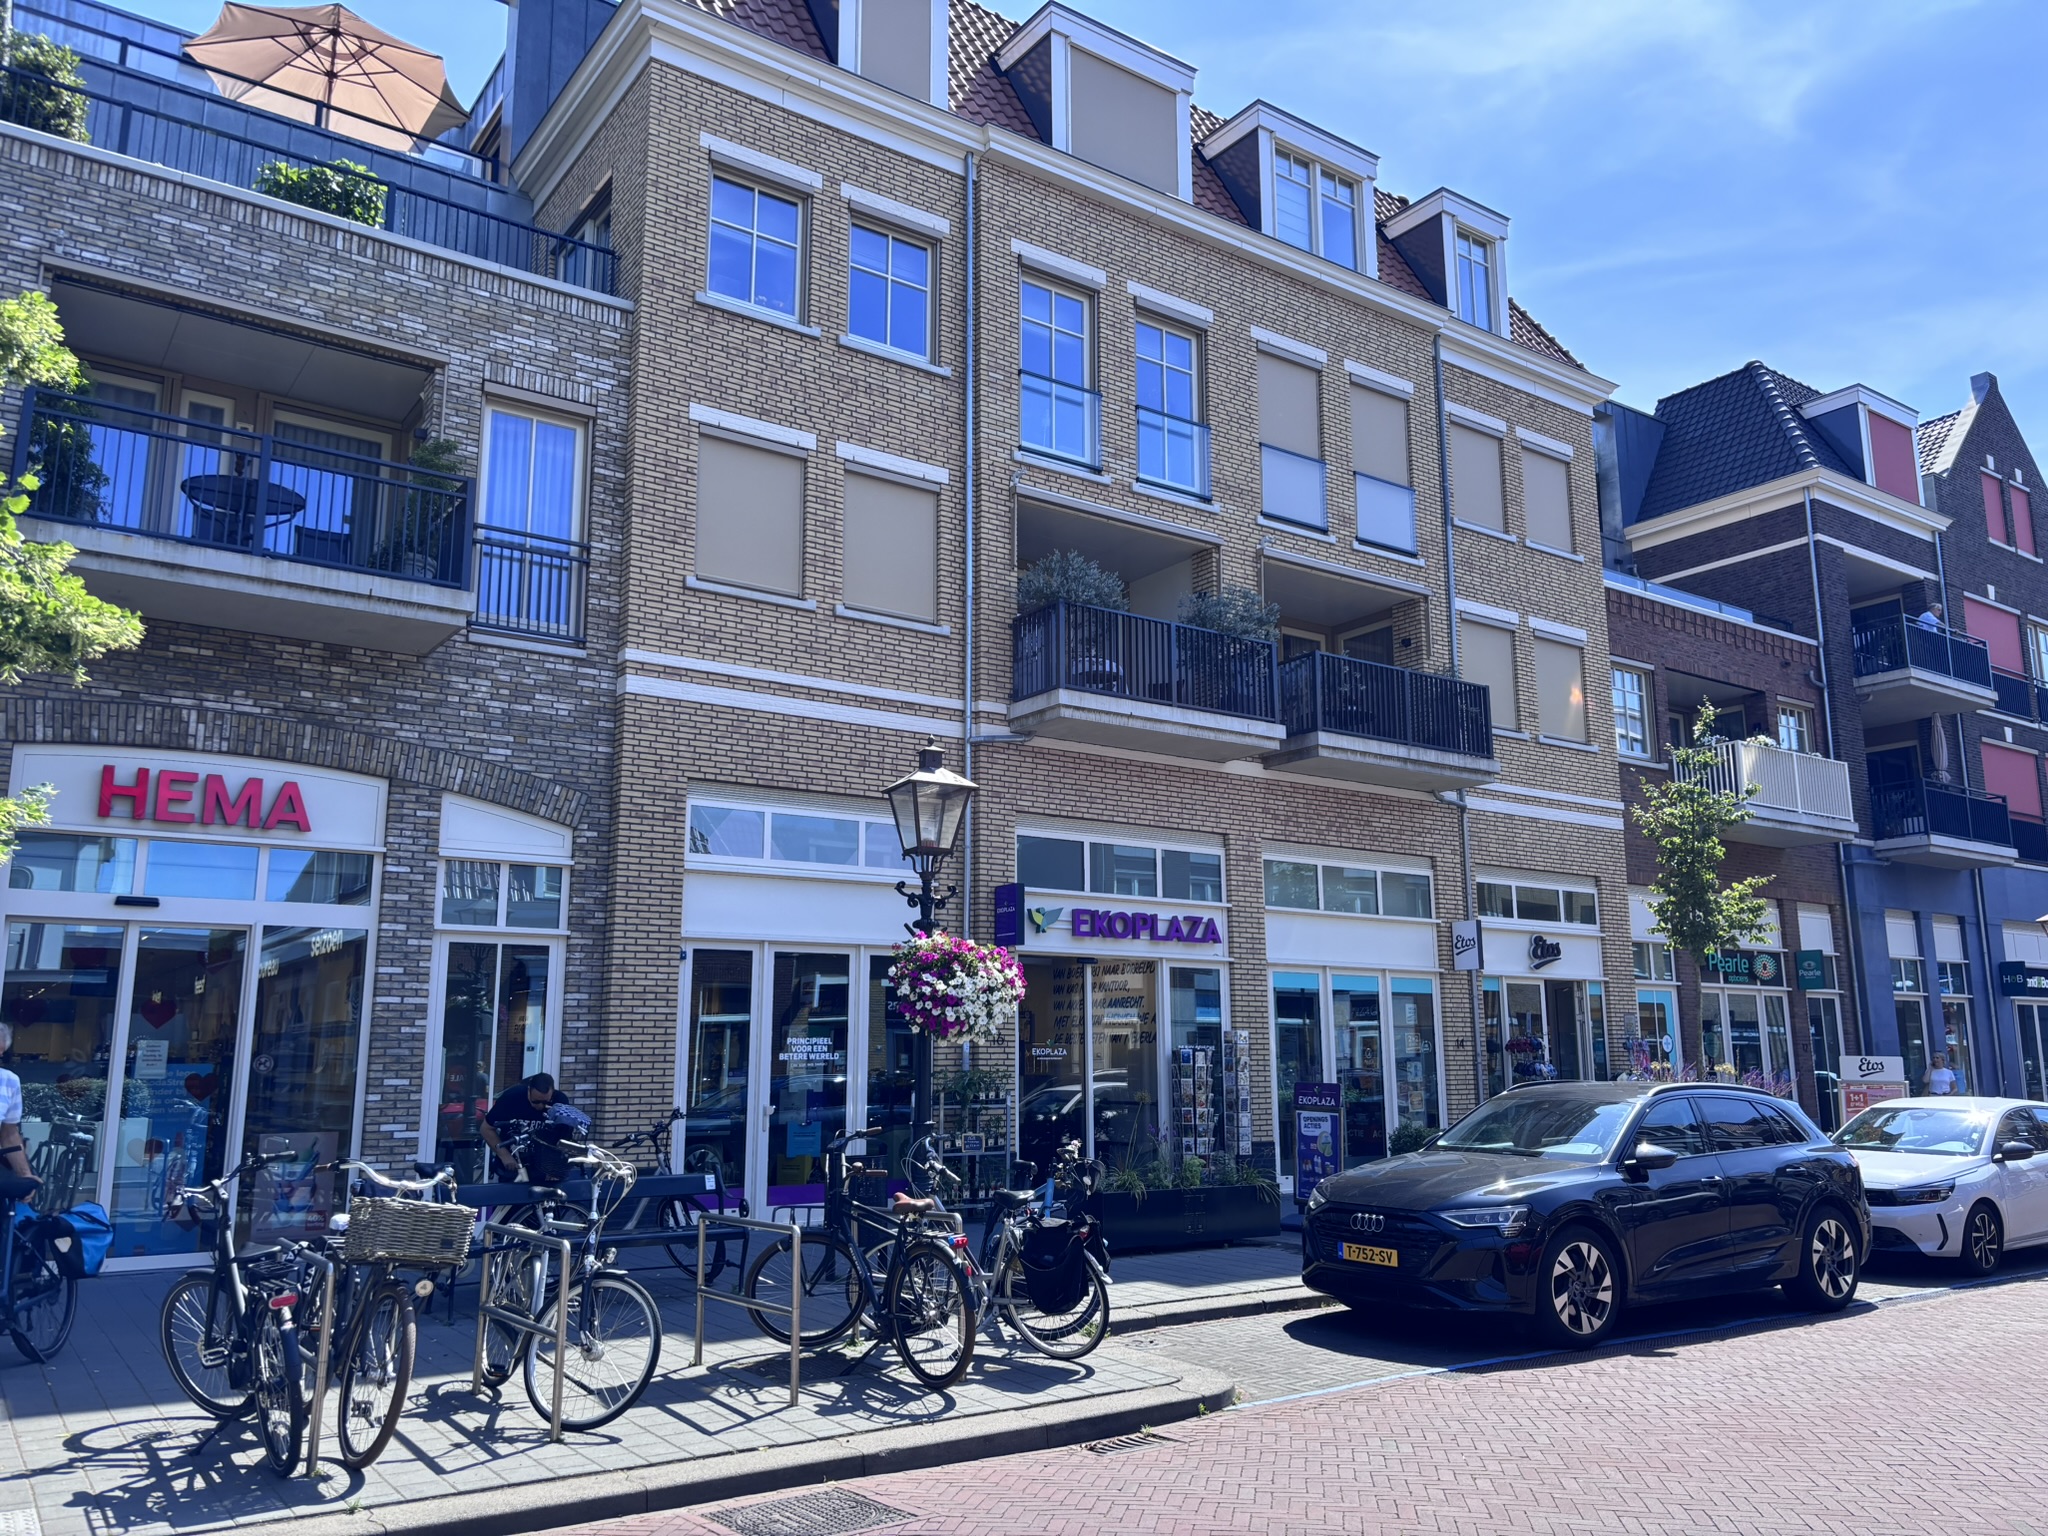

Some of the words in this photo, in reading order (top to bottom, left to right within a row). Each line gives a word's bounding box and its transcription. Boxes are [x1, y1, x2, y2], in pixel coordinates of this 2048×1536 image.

[98, 765, 312, 832] HEMA
[1072, 908, 1222, 944] EKOPLAZA
[310, 928, 344, 957] seizoen
[1454, 934, 1476, 950] Etos
[1531, 934, 1562, 960] Etos
[1102, 964, 1120, 977] NAAR
[1708, 953, 1749, 973] Pearle
[779, 1052, 808, 1060] BETERE
[808, 1052, 839, 1060] WERELD
[1032, 1047, 1068, 1056] EKOPLAZA
[1858, 1057, 1884, 1072] Etos
[1298, 1095, 1336, 1106] EKOPLAZA
[1849, 1093, 1864, 1102] 1+1
[1346, 1245, 1393, 1264] T-752-SV
